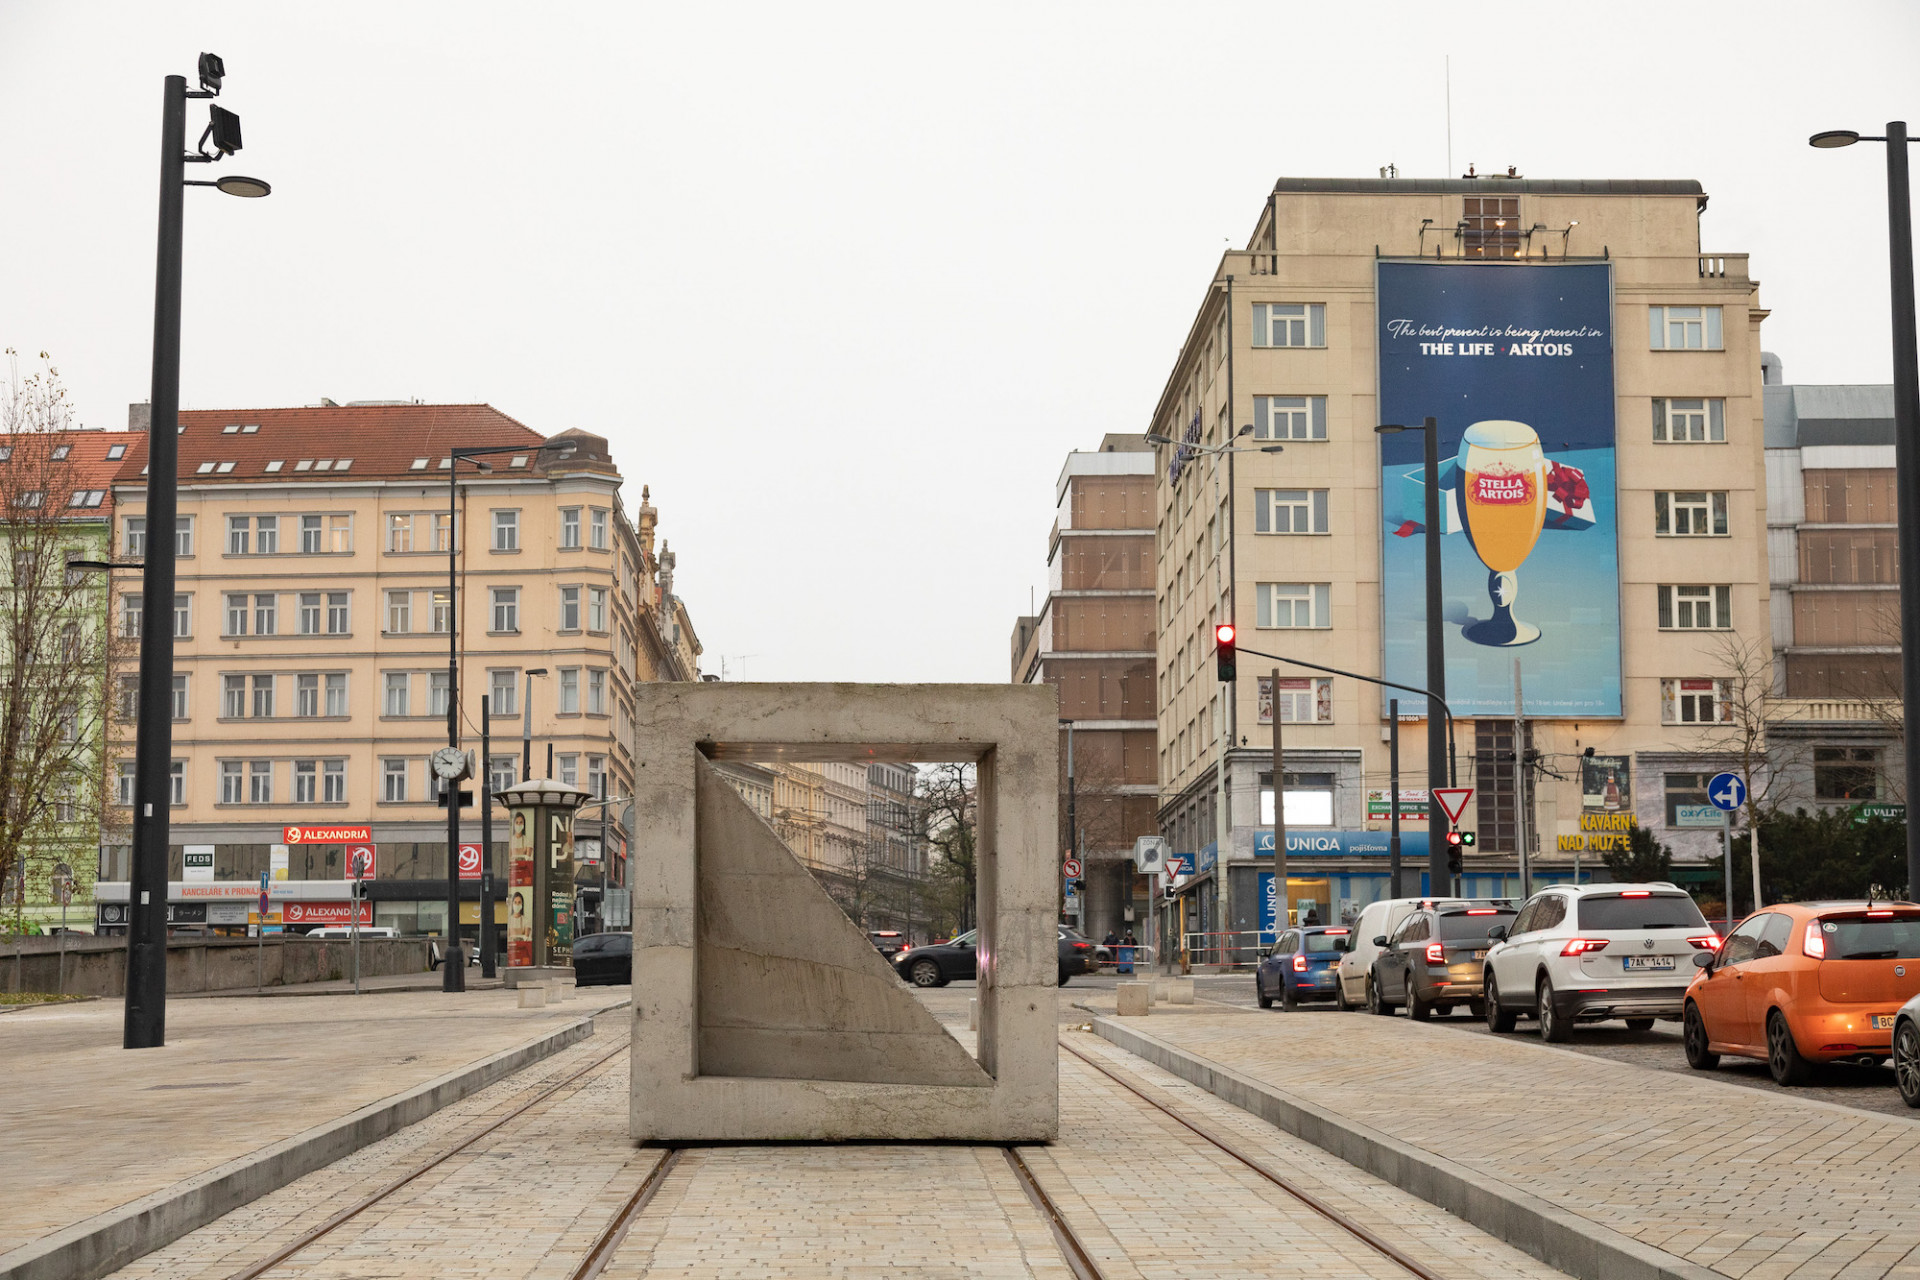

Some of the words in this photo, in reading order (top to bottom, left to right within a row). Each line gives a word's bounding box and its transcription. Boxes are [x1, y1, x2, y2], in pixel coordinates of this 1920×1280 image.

[1387, 319, 1416, 339] The
[1419, 324, 1443, 336] best
[1441, 325, 1488, 341] present
[1489, 328, 1502, 337] is
[1505, 324, 1541, 343] being
[1539, 325, 1587, 342] present
[1588, 329, 1604, 337] in
[1420, 343, 1454, 355] THE
[1459, 343, 1495, 355] LIFE
[1509, 343, 1573, 356] ARTOIS
[1479, 478, 1523, 489] STELLA
[1479, 489, 1525, 499] ARTOIS
[1863, 808, 1871, 817] U
[304, 830, 368, 839] ALEXANDRIA
[1286, 837, 1340, 851] UNIQA
[1349, 843, 1388, 853] pojišťovna
[1557, 834, 1585, 851] NAD
[182, 886, 223, 896] KANCELÁŘE
[225, 887, 230, 896] K
[1266, 876, 1277, 917] UNIQA
[1630, 958, 1646, 966] 7AK
[1652, 958, 1671, 966] 1414
[1880, 1017, 1897, 1027] 8C
